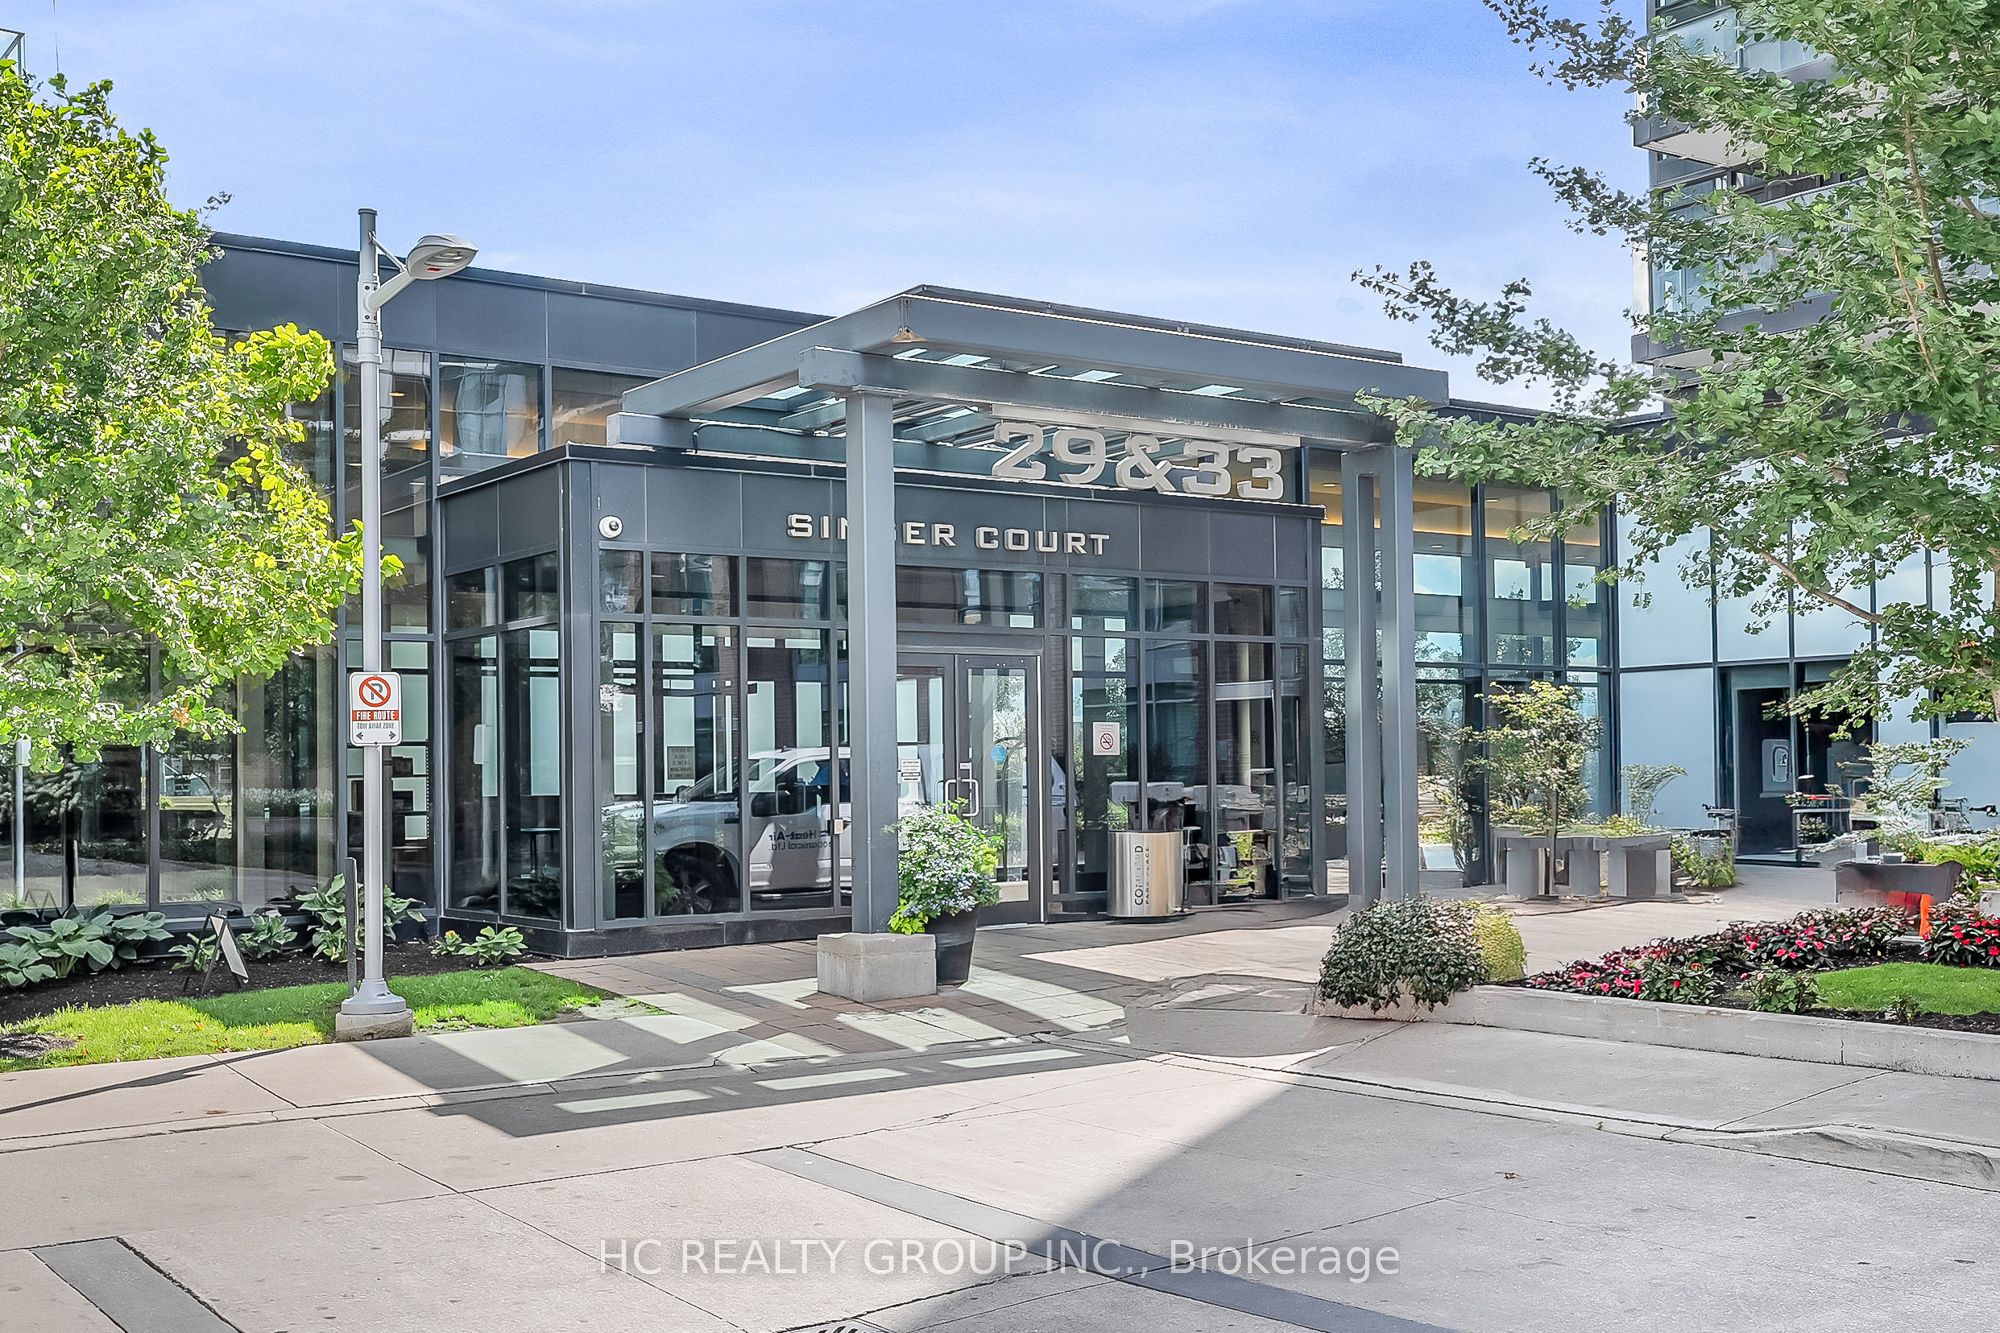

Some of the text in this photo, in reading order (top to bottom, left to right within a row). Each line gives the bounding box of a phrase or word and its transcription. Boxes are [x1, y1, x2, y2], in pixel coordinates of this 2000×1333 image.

[975, 526, 1110, 555] COURT
[356, 710, 395, 721] FIRE ROUTE
